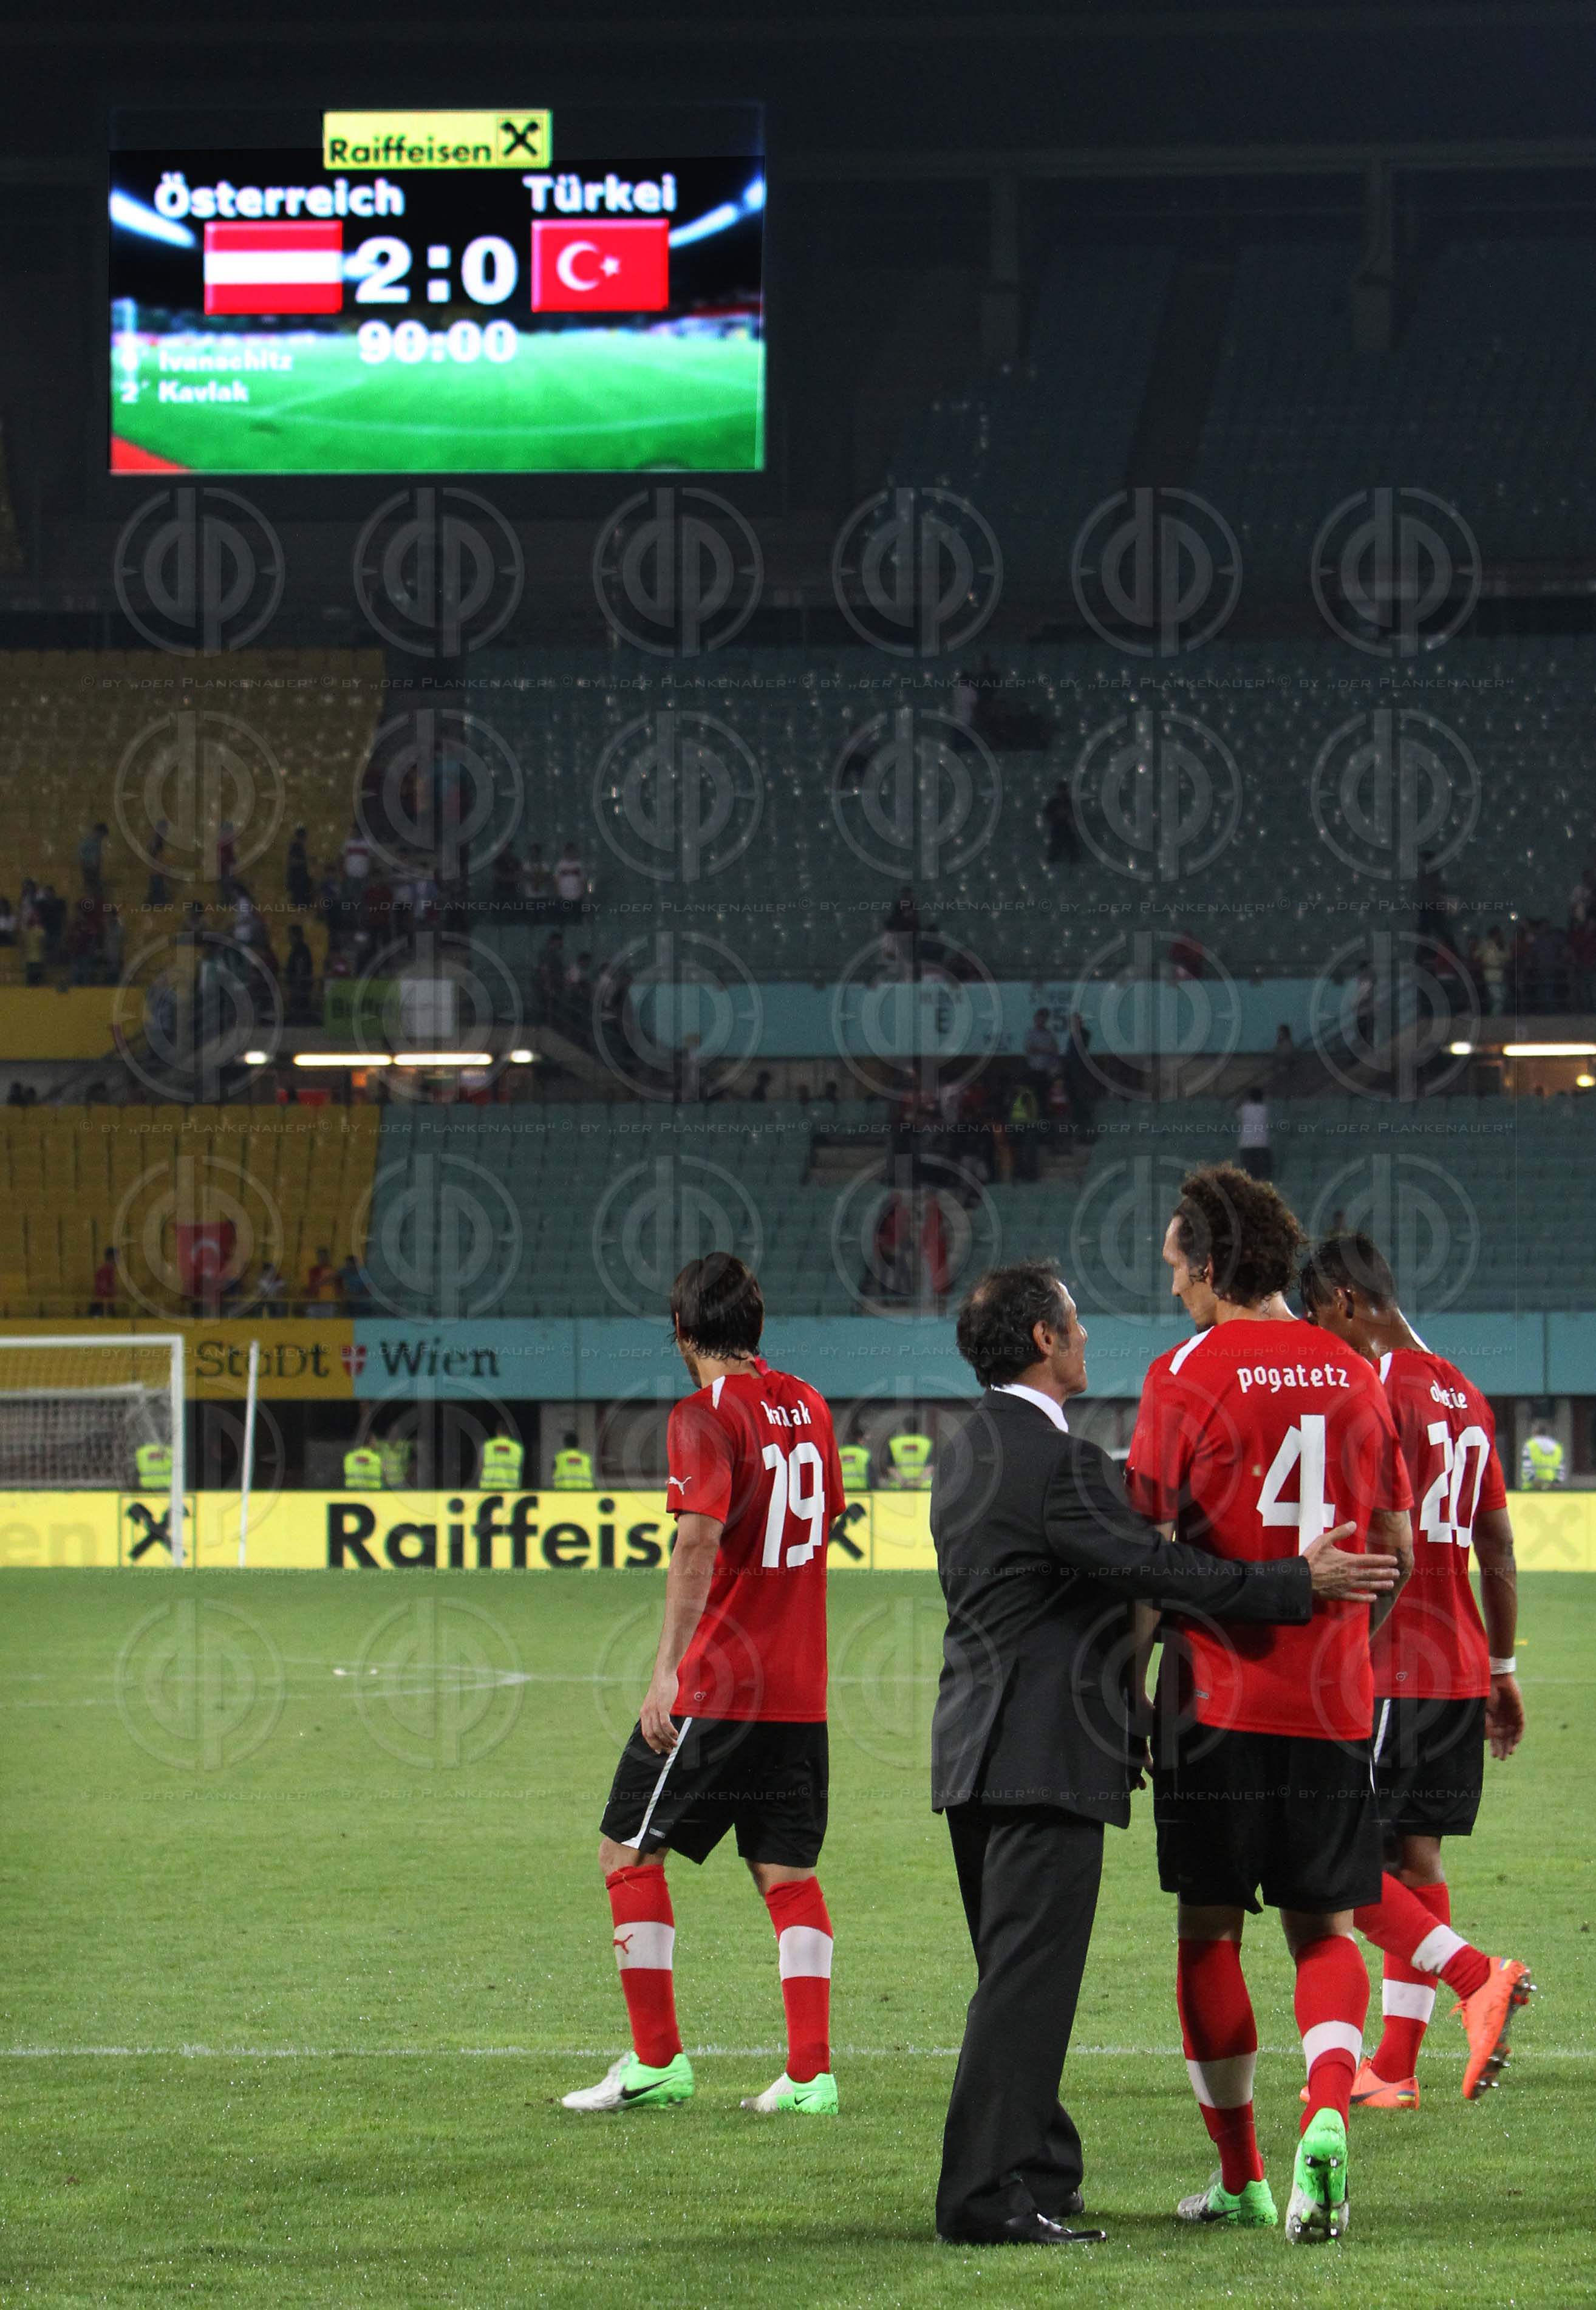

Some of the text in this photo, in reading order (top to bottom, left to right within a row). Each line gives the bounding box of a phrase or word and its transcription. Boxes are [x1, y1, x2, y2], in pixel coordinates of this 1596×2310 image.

[329, 135, 493, 165] Raiffeisen
[154, 172, 405, 217] Österreich
[522, 174, 677, 213] Türkei
[355, 235, 518, 305] 2:0
[358, 319, 518, 363] 90:00
[158, 379, 250, 403] Kavlak
[379, 1337, 500, 1377] Wien
[1237, 1364, 1349, 1394] pogatetz
[762, 1442, 825, 1568] 19
[1256, 1414, 1335, 1556] 4
[1419, 1420, 1490, 1548] 20
[328, 1496, 678, 1569] Raiffeis
